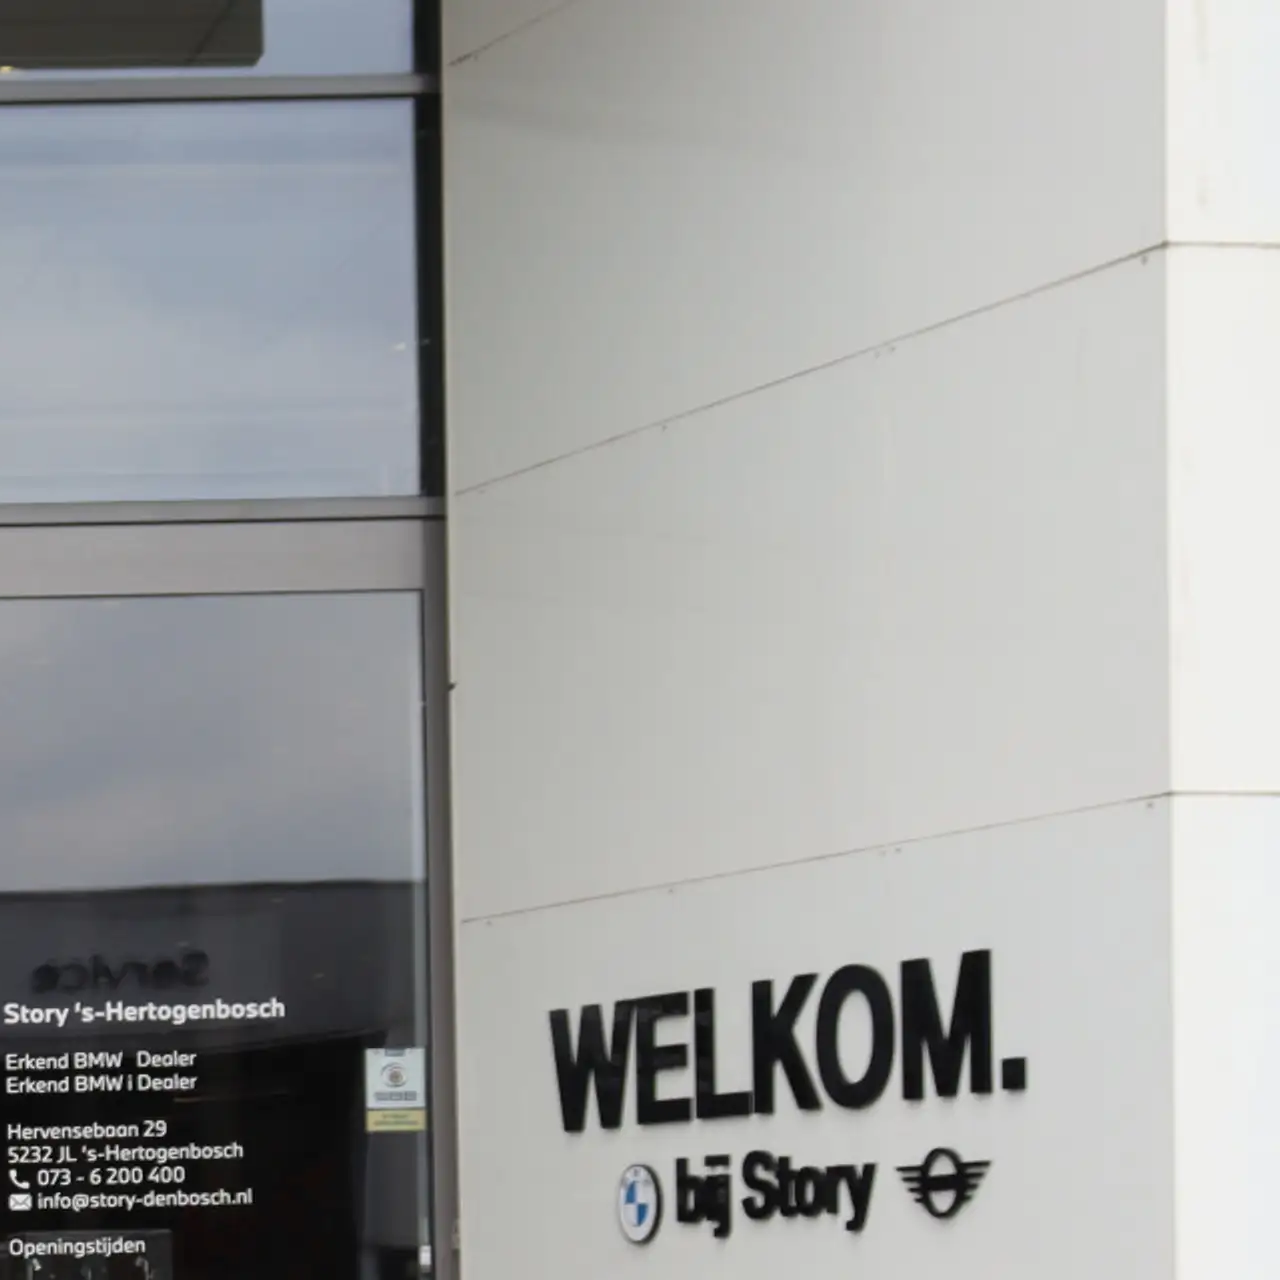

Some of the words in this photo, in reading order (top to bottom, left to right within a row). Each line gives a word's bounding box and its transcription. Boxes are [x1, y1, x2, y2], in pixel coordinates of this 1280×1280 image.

[3, 1002, 69, 1027] Story
[549, 949, 1027, 1132] WELKOM.
[5, 1053, 69, 1070] Erkend
[74, 1051, 123, 1069] BMW
[136, 1050, 197, 1067] Dealer
[6, 1075, 69, 1093] Erkend
[74, 1074, 124, 1092] BMW
[127, 1074, 133, 1090] i
[137, 1073, 197, 1090] Dealer
[7, 1122, 139, 1140] Hervensebaan
[143, 1120, 168, 1137] 29
[7, 1145, 53, 1163] 5232
[56, 1145, 77, 1163] JL
[81, 1141, 244, 1163] 's-Hertogenbosch
[37, 1168, 71, 1186] 073
[89, 1168, 102, 1185] 6
[106, 1166, 143, 1184] 200
[147, 1165, 186, 1183] 400
[37, 1188, 253, 1212] info@story-denbosch.nl
[676, 1154, 731, 1238] bij
[742, 1150, 878, 1232] Story
[9, 1237, 146, 1258] Openingstijden
